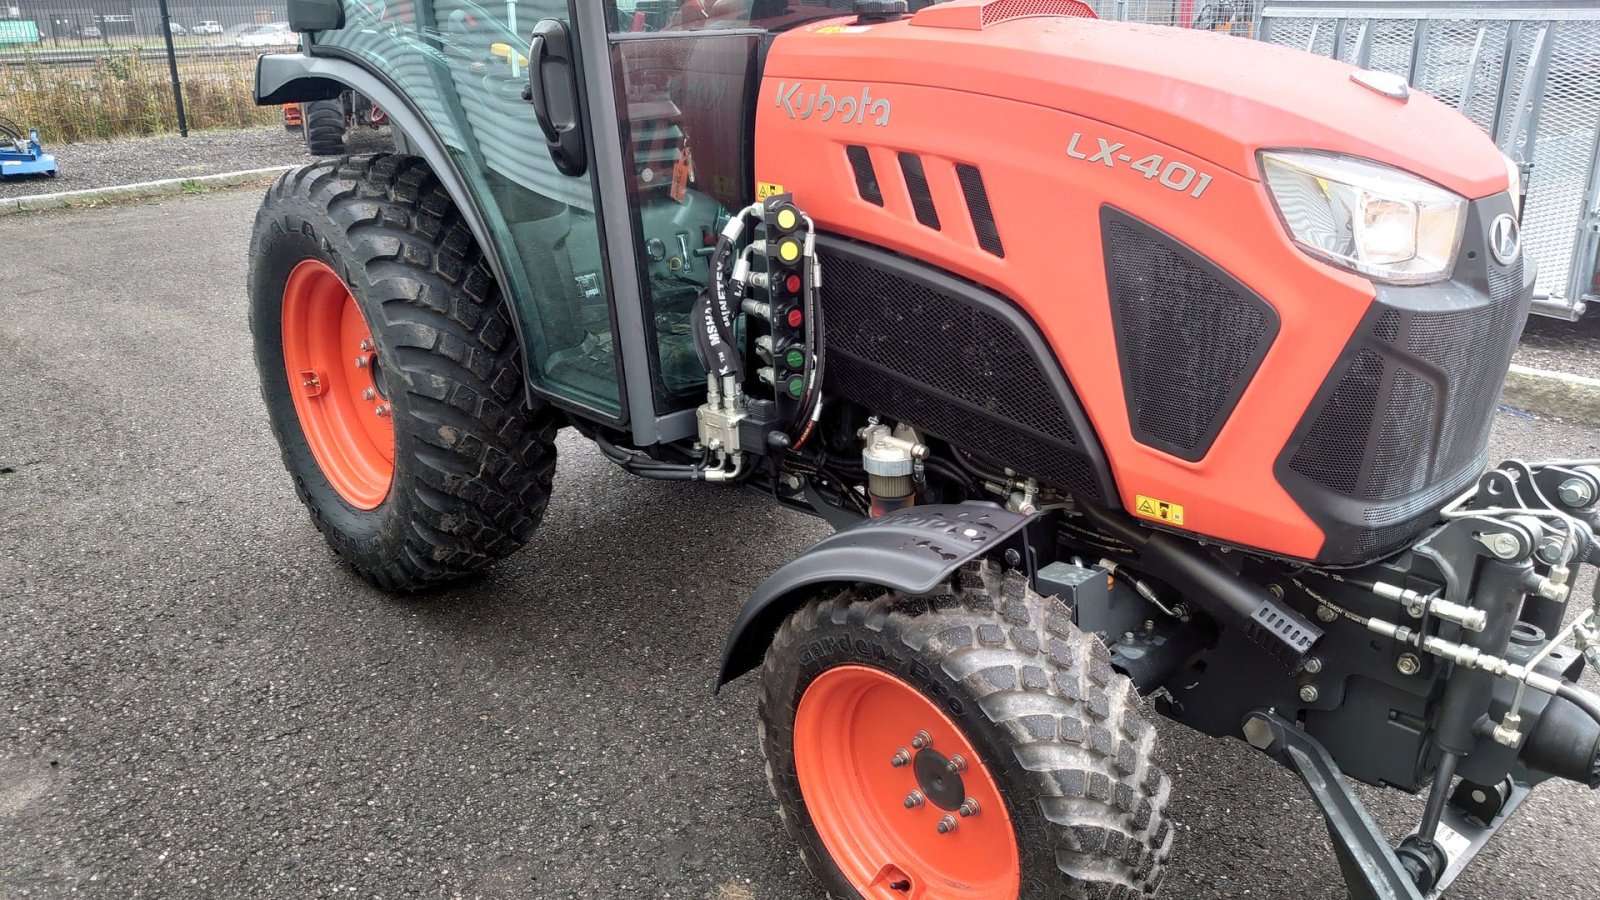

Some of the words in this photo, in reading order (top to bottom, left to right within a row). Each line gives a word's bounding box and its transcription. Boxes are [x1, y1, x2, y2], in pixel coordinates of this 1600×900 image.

[775, 81, 891, 127] Kubota
[1066, 132, 1213, 198] LX-401
[260, 215, 359, 288] GALAXY
